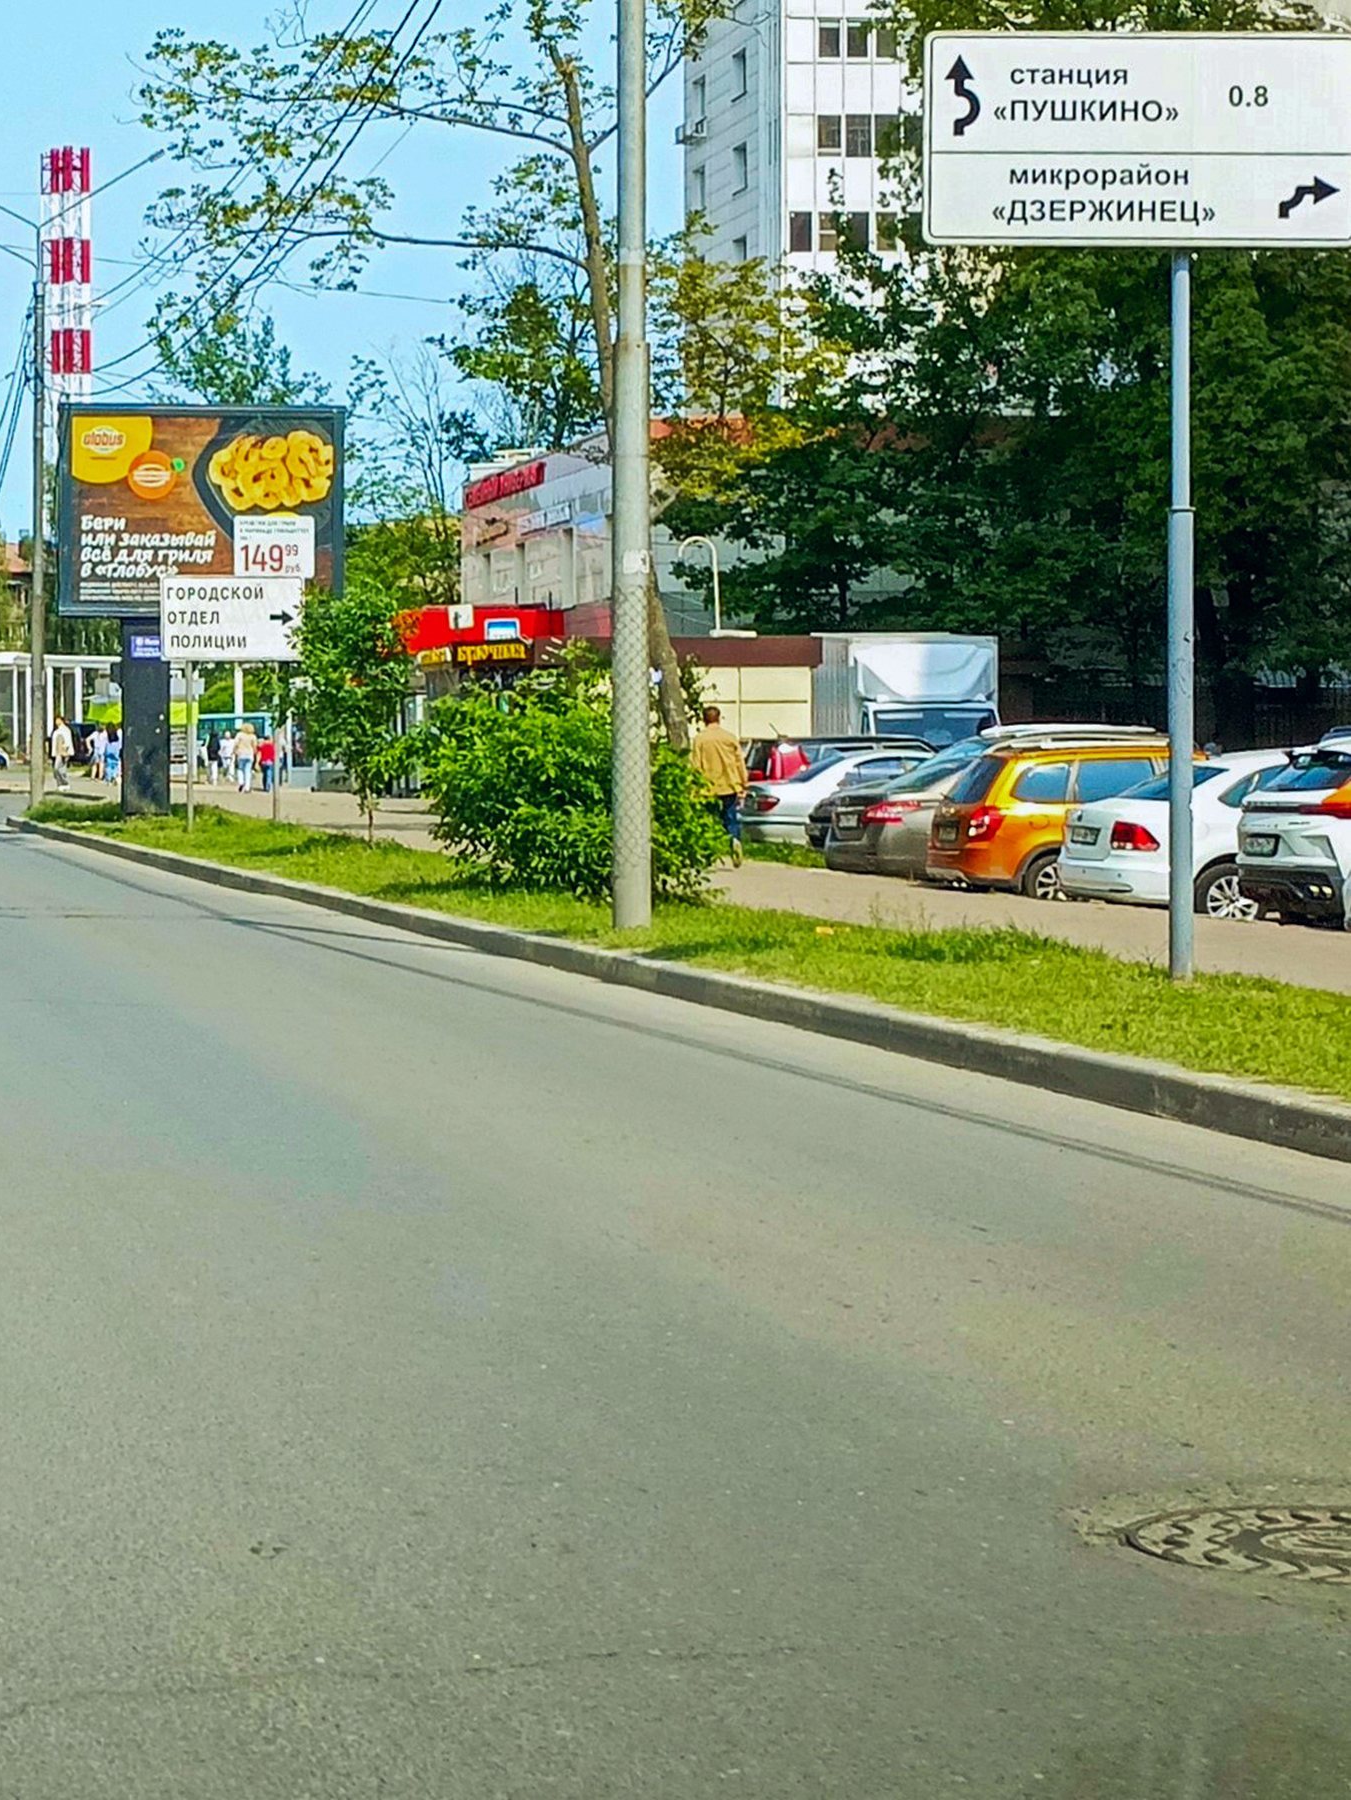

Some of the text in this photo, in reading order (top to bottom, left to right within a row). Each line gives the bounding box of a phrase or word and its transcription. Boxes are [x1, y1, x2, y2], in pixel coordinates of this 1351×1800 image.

[1010, 68, 1128, 89] станция
[1228, 85, 1269, 108] 0.8
[993, 99, 1180, 123] «ПУШКИНО»
[1009, 163, 1189, 191] микрорайон
[992, 199, 1216, 227] «ДЗЕРЖИНЕЦ»
[81, 514, 126, 531] Бери
[80, 530, 217, 547] или заказывай
[114, 549, 154, 564] для
[157, 549, 214, 564] гриля
[240, 543, 299, 573] 149 99
[80, 562, 93, 578] в
[166, 586, 264, 602] ГОРОДСКОЙ
[167, 610, 220, 626] ОТДЕЛ
[170, 634, 247, 651] ПОЛИЦИИ
